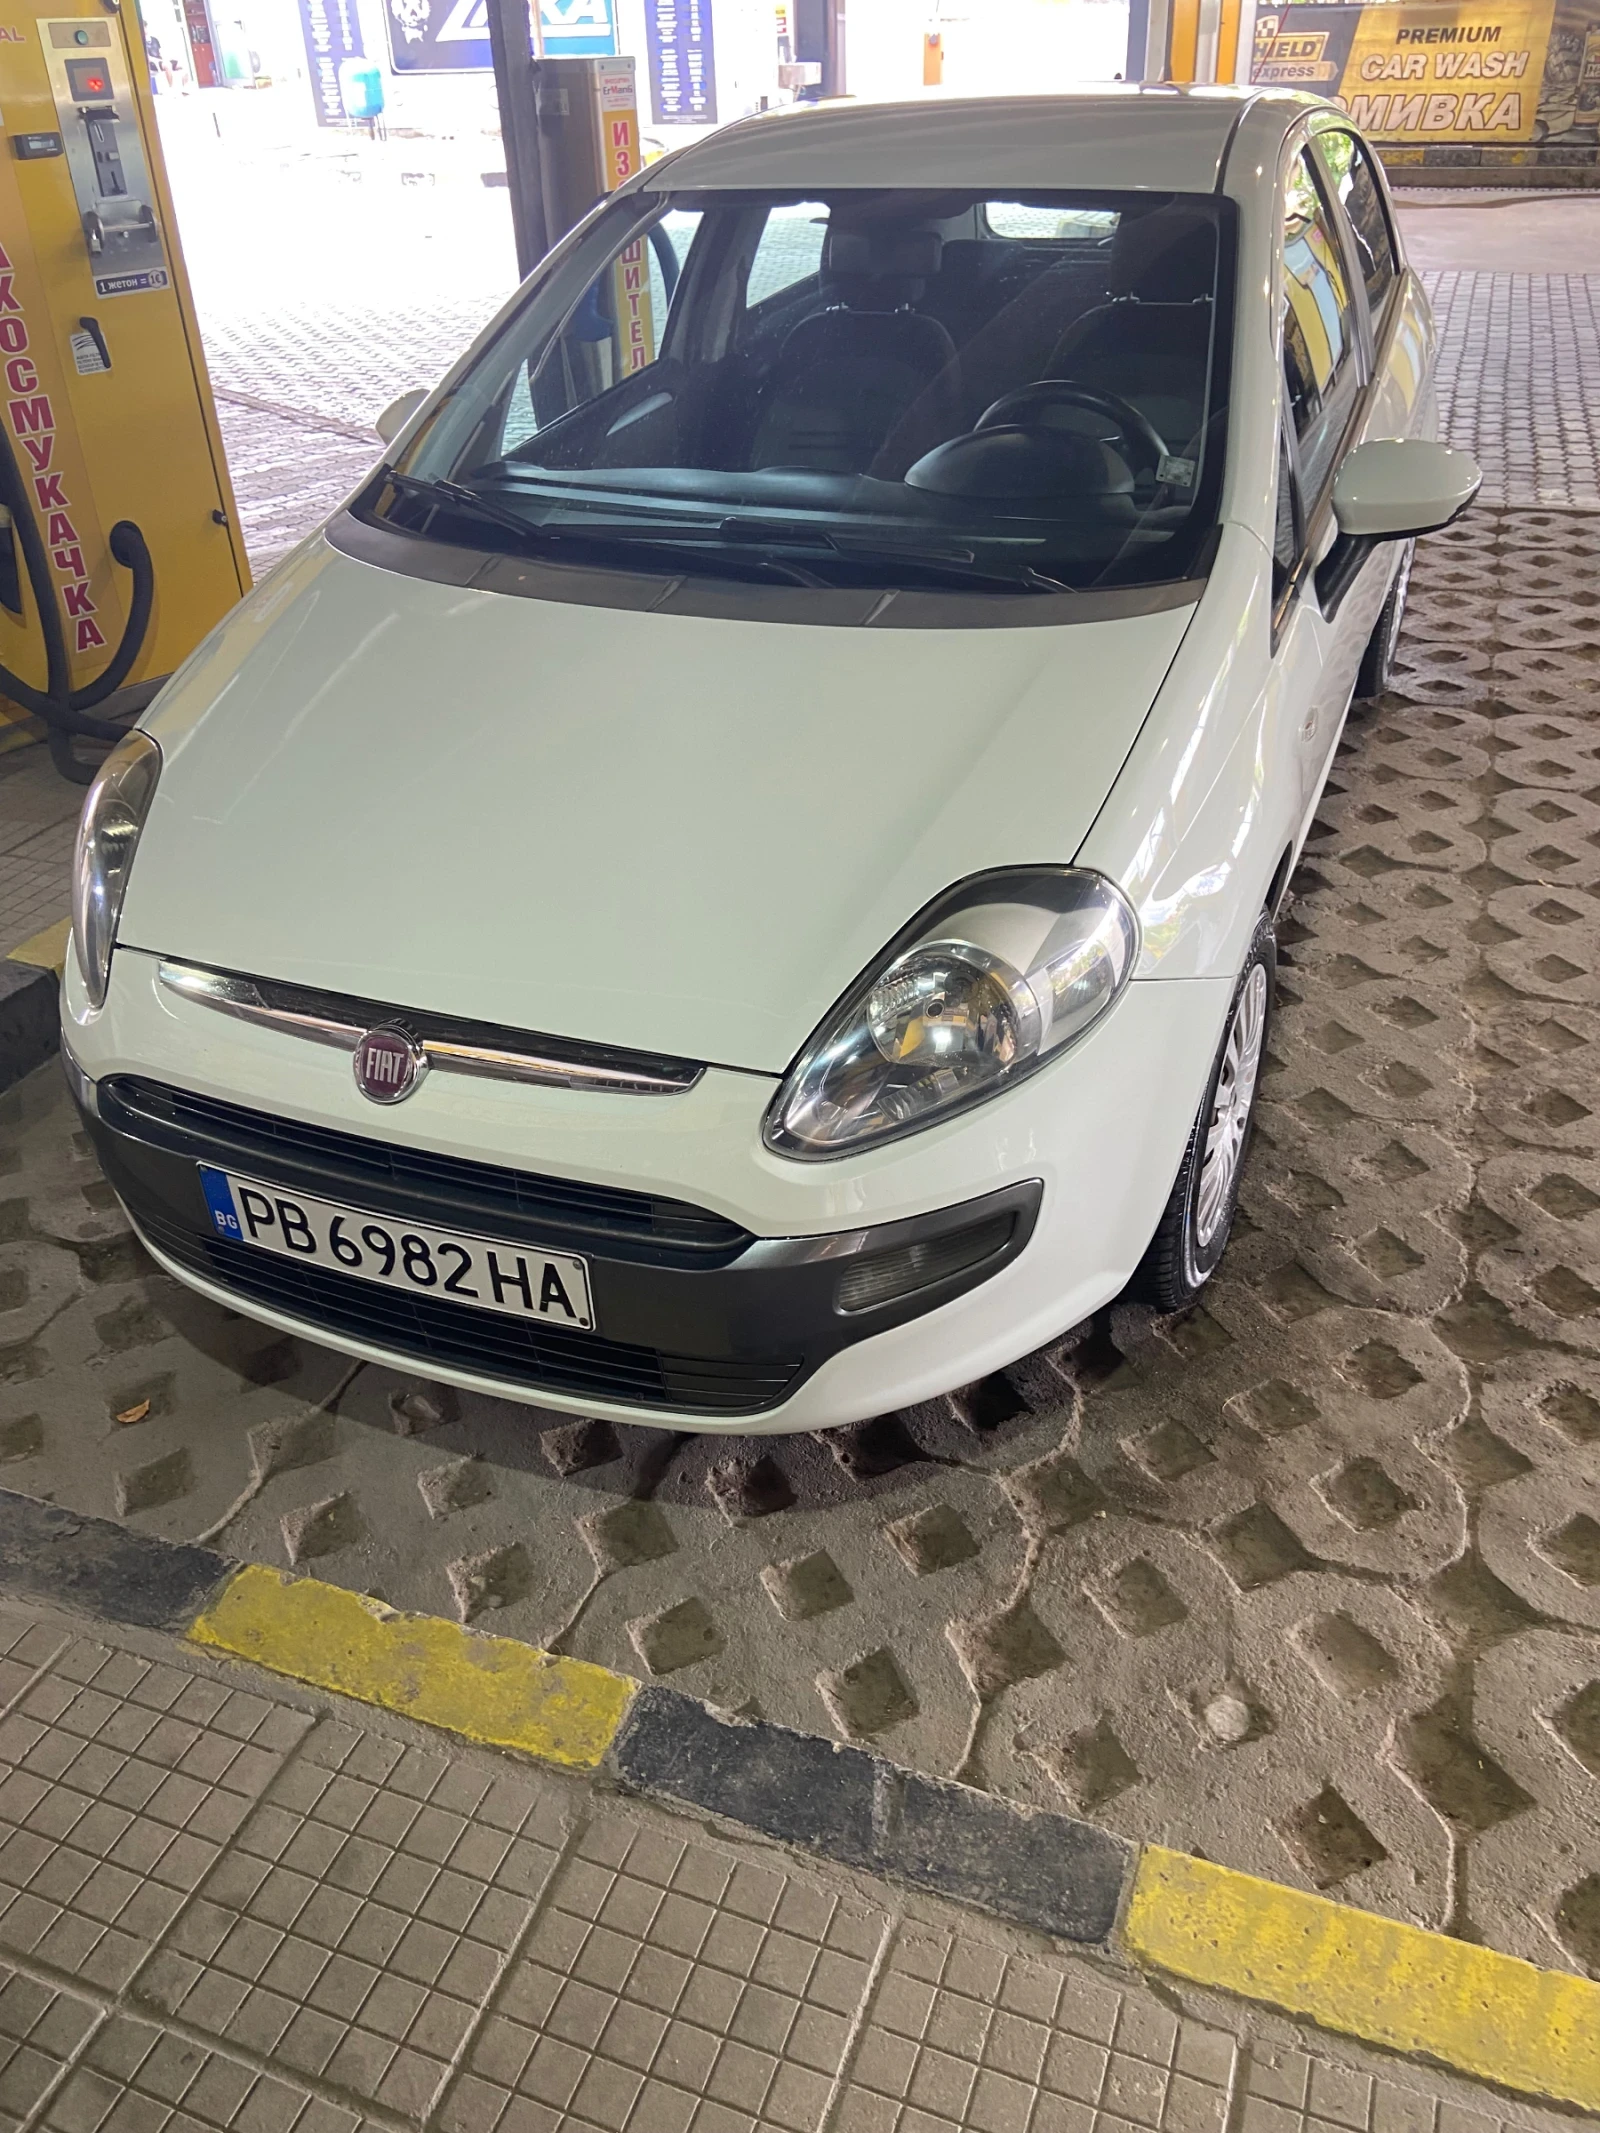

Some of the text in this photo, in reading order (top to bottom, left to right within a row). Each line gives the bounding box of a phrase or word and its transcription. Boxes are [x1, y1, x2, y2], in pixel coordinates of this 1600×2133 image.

[1396, 26, 1501, 45] PREMIUM
[1252, 41, 1317, 58] HIELD
[1252, 66, 1315, 80] express
[1361, 51, 1530, 80] CAR WASH
[100, 281, 107, 292] 1
[108, 279, 138, 290] жетон
[366, 1047, 404, 1084] FIAT
[214, 1209, 238, 1230] BG
[329, 1215, 480, 1298] 6982
